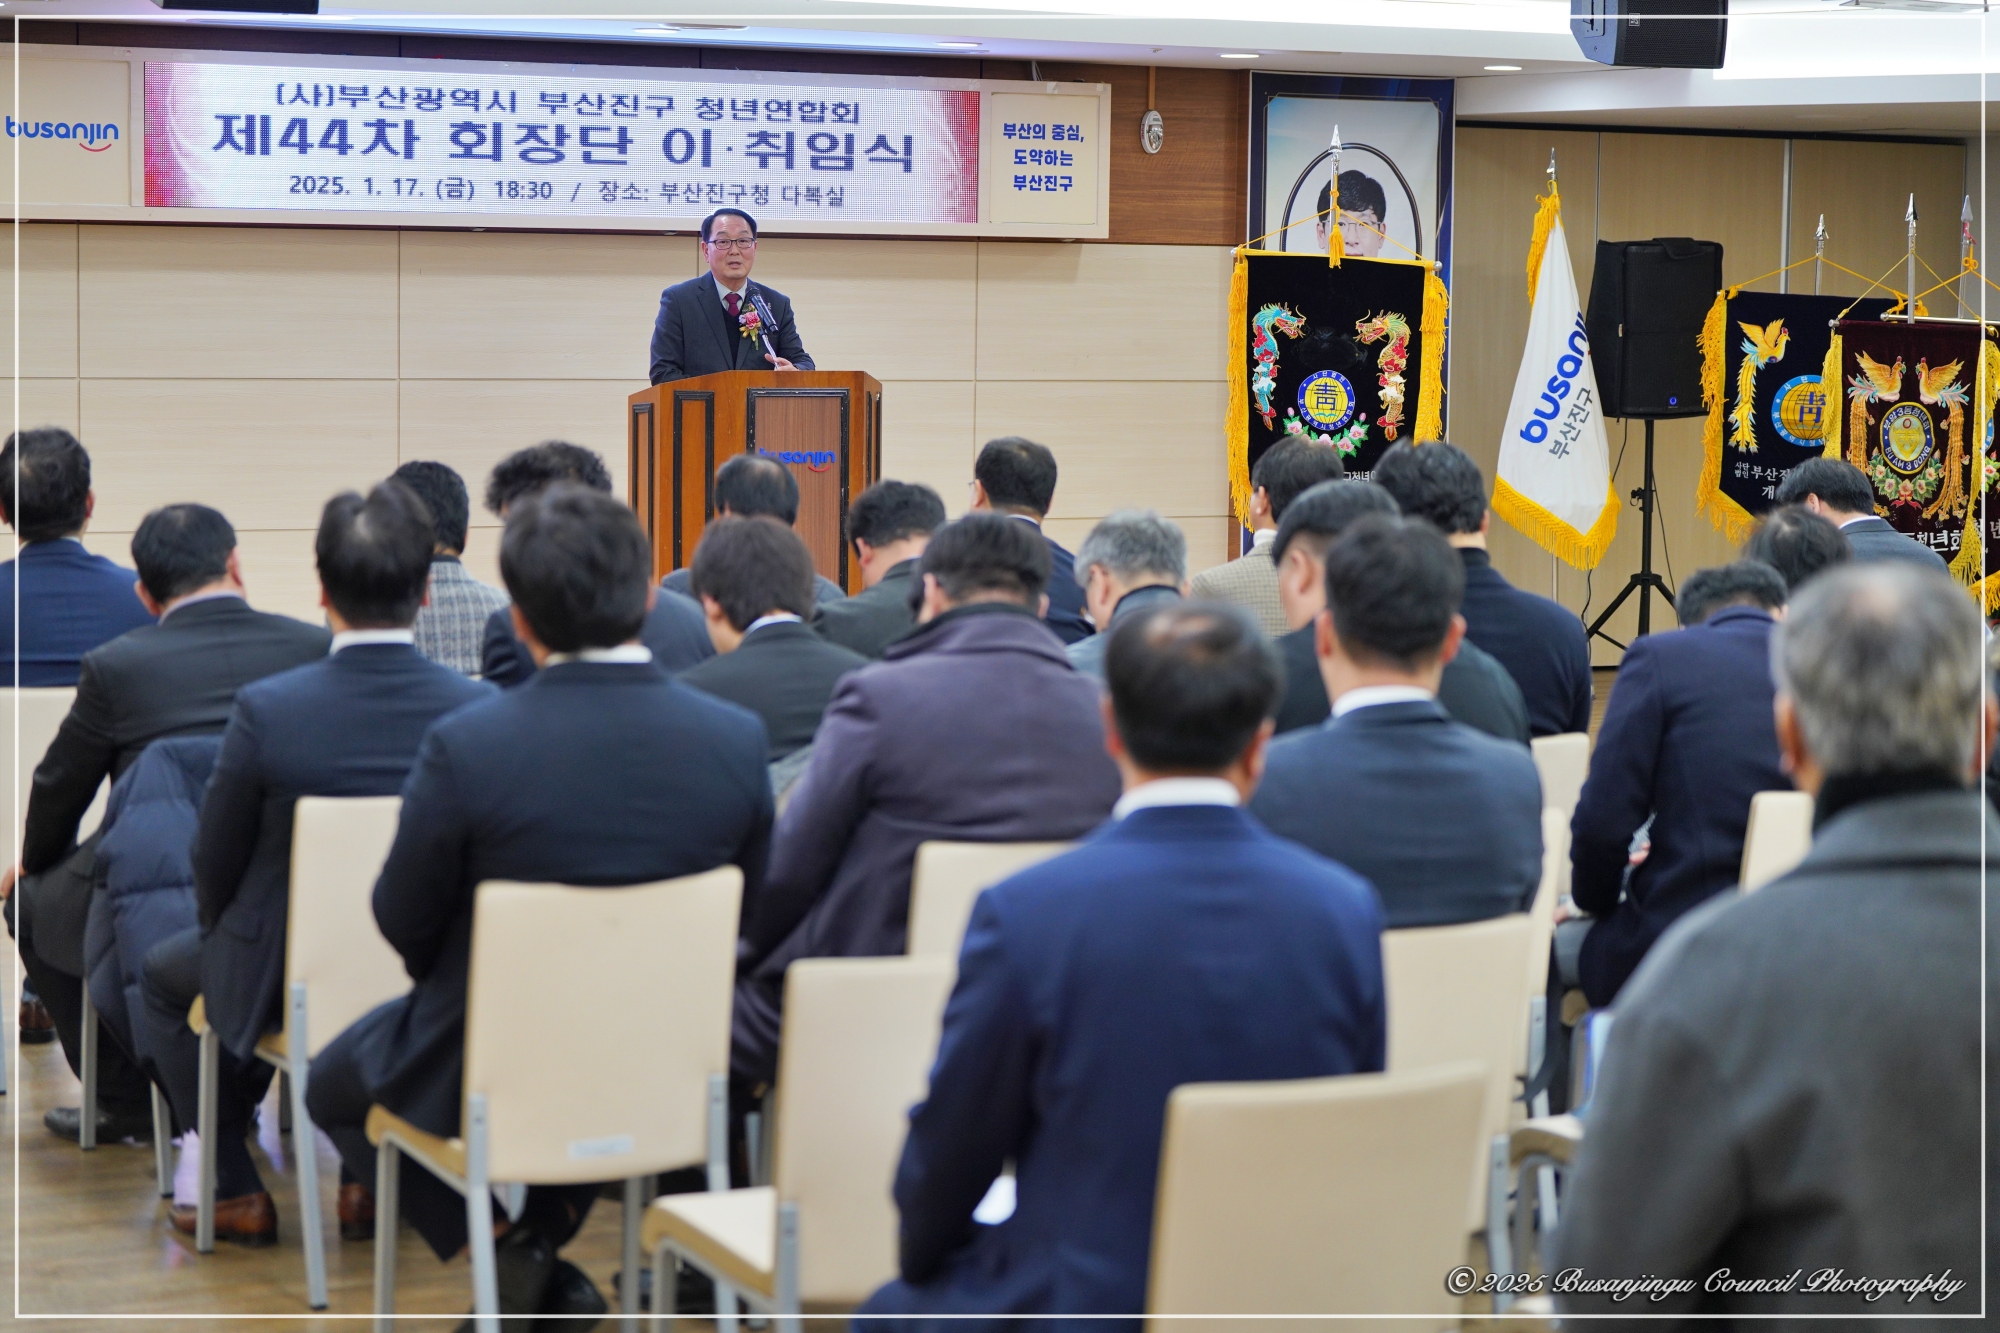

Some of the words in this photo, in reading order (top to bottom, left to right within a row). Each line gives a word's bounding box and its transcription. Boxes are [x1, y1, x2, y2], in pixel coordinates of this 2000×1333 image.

[276, 83, 517, 114] [사]부산광역시
[537, 91, 675, 119] 부산진구
[695, 97, 860, 125] 청년연합회
[5, 116, 119, 146] busanjin
[212, 114, 421, 160] 제44차
[449, 121, 634, 166] 회장단
[1003, 122, 1046, 140] 부산의
[1051, 124, 1085, 143] 중심,
[1013, 149, 1073, 167] 도약하는
[289, 175, 351, 195] 2025.
[363, 176, 382, 196] 1.
[392, 177, 424, 197] 17.
[435, 175, 475, 200] (금)
[494, 180, 554, 200] 18:30
[597, 180, 649, 202] 장소:
[659, 182, 769, 206] 부산진구청
[782, 185, 844, 208] 다복실
[1013, 174, 1073, 192] 부산진구
[1548, 387, 1593, 459] 부산진구
